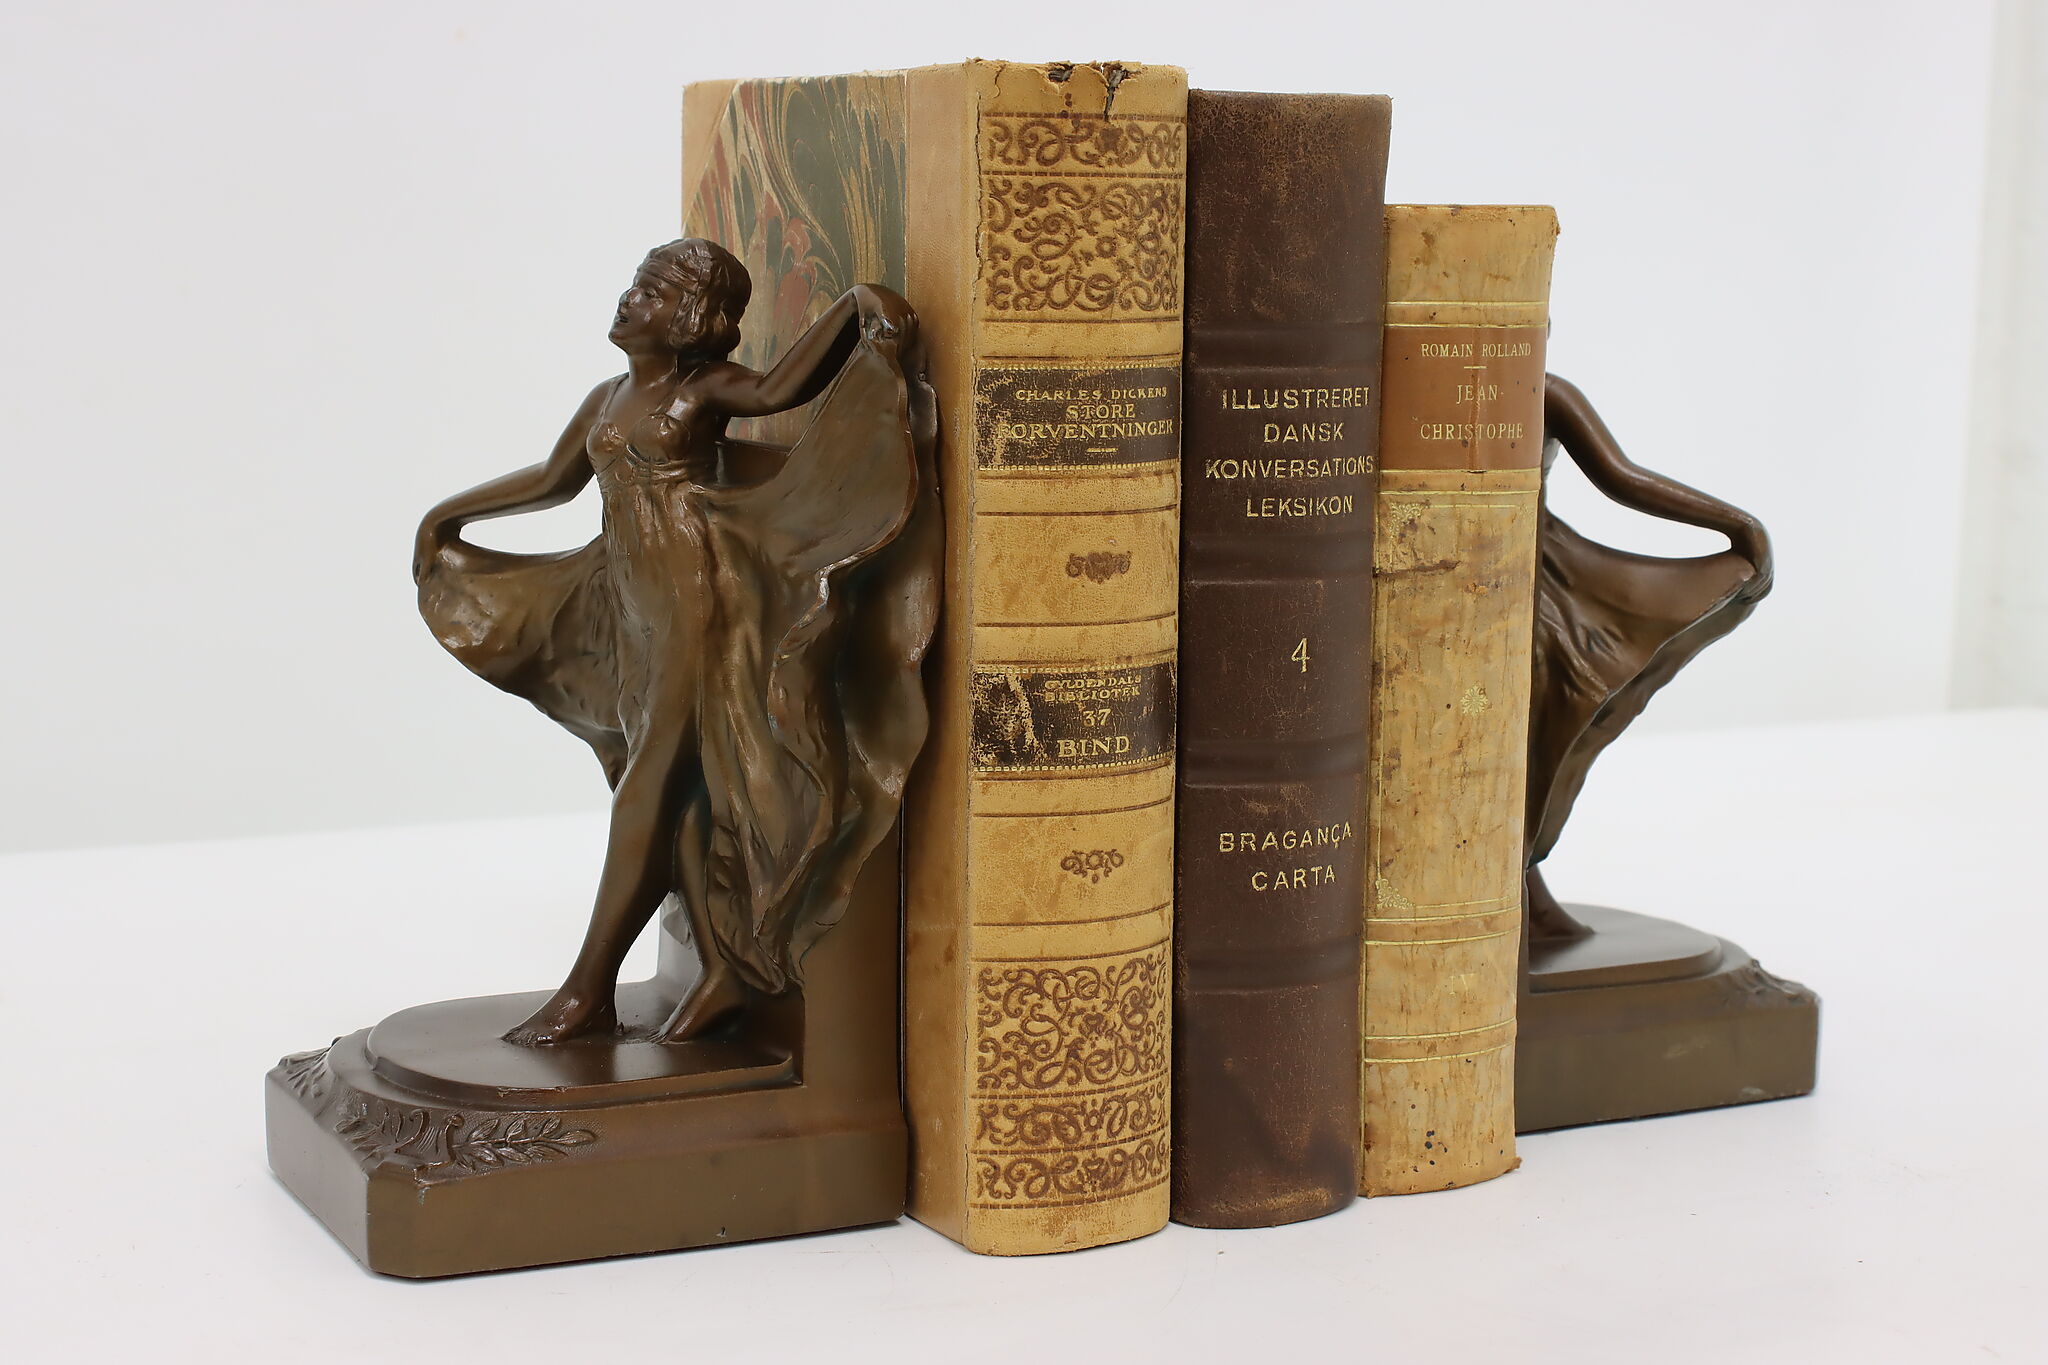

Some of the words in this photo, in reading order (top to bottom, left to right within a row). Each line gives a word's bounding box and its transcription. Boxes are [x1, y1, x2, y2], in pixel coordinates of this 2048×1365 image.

[1420, 343, 1473, 357] ROMAIN
[1481, 342, 1531, 357] ROLLAND
[1015, 388, 1102, 401] CHARLES
[1111, 386, 1168, 399] DICKENS
[1222, 387, 1370, 410] ILLUSTRERET
[1065, 403, 1136, 420] STORE
[1263, 422, 1345, 443] DANSK
[1420, 423, 1523, 440] CHRISTOPHE
[1205, 455, 1375, 479] KONVERSATIONS
[1246, 495, 1353, 518] LEKSIKON
[1290, 637, 1310, 673] 4
[1044, 674, 1142, 690] GYLDENDALS
[1044, 686, 1141, 702] BIBLIOTEK
[1083, 708, 1112, 728] 37
[1058, 735, 1131, 758] BIND
[1219, 821, 1352, 853] BRAGANÇA
[1251, 865, 1336, 892] CARTA
